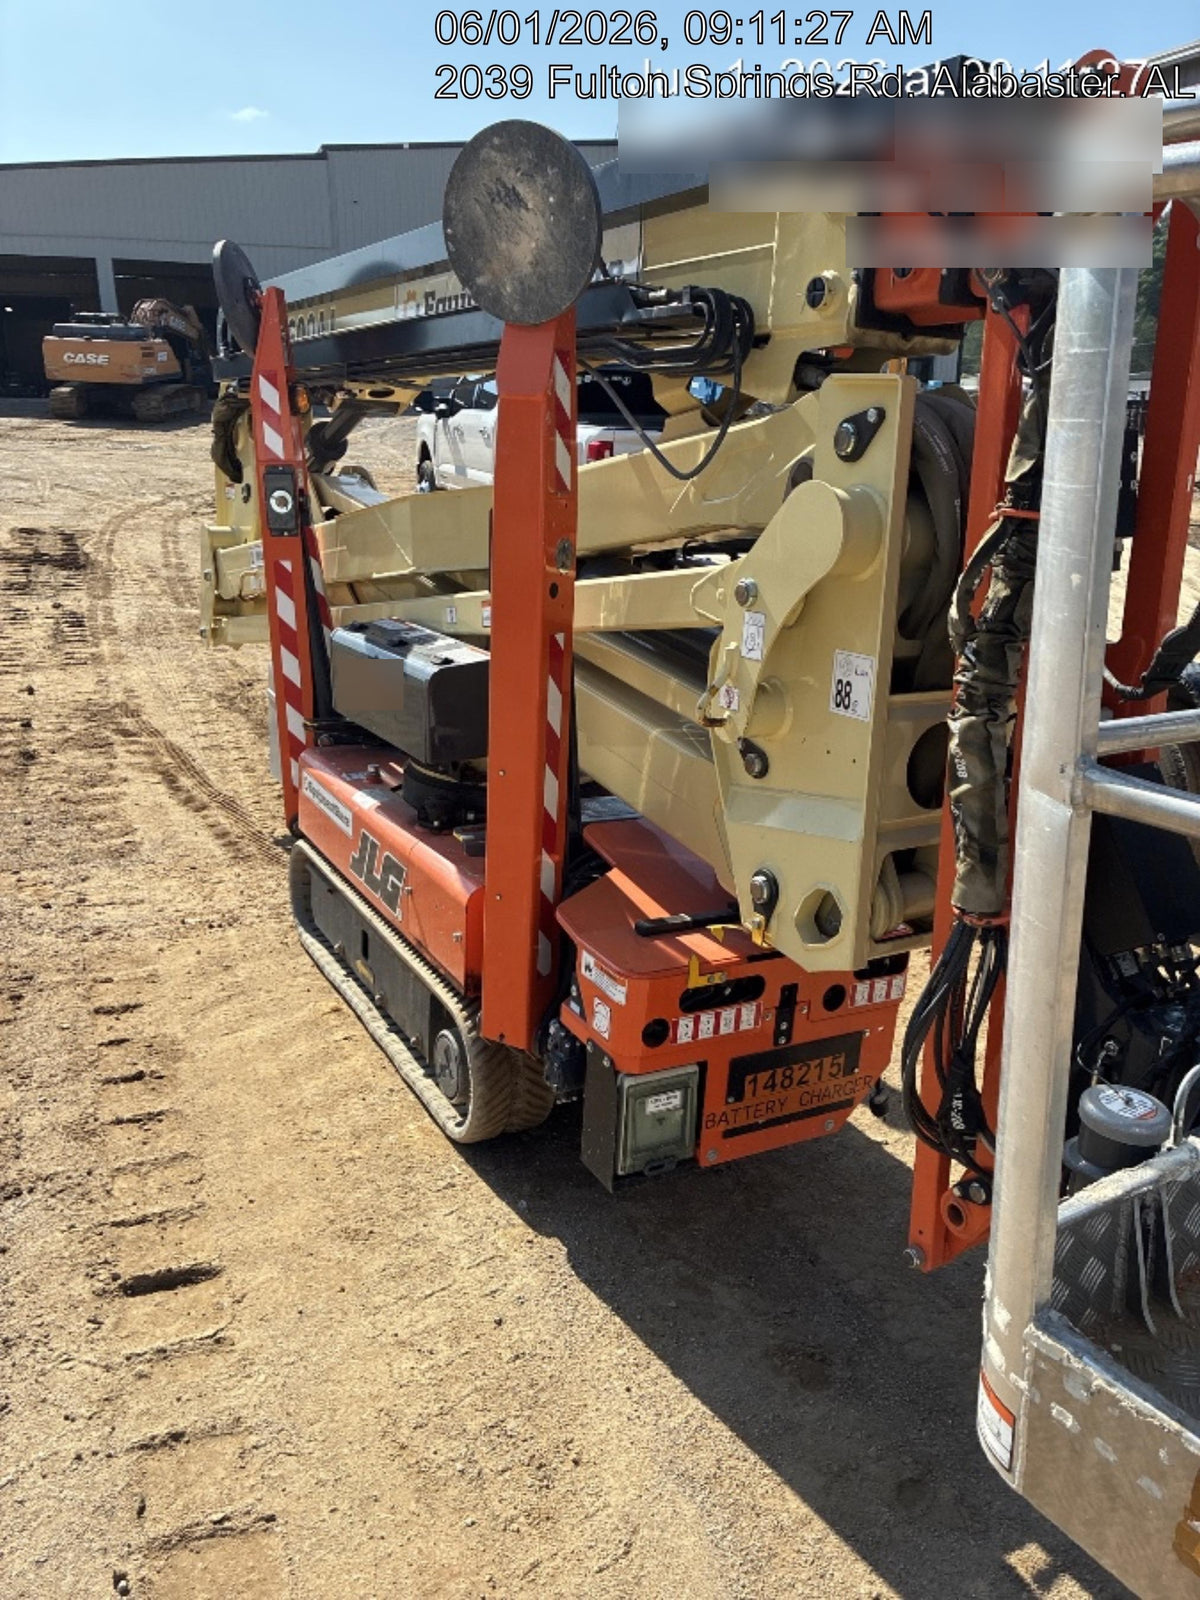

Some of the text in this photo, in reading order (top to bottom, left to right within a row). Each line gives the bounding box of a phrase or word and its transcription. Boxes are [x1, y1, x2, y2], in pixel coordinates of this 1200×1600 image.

[63, 352, 110, 365] CASE
[835, 679, 852, 710] 88
[350, 829, 407, 917] JLG
[748, 1054, 842, 1098] 148215
[705, 1096, 788, 1130] BATTERY
[799, 1075, 873, 1107] CHARGER
